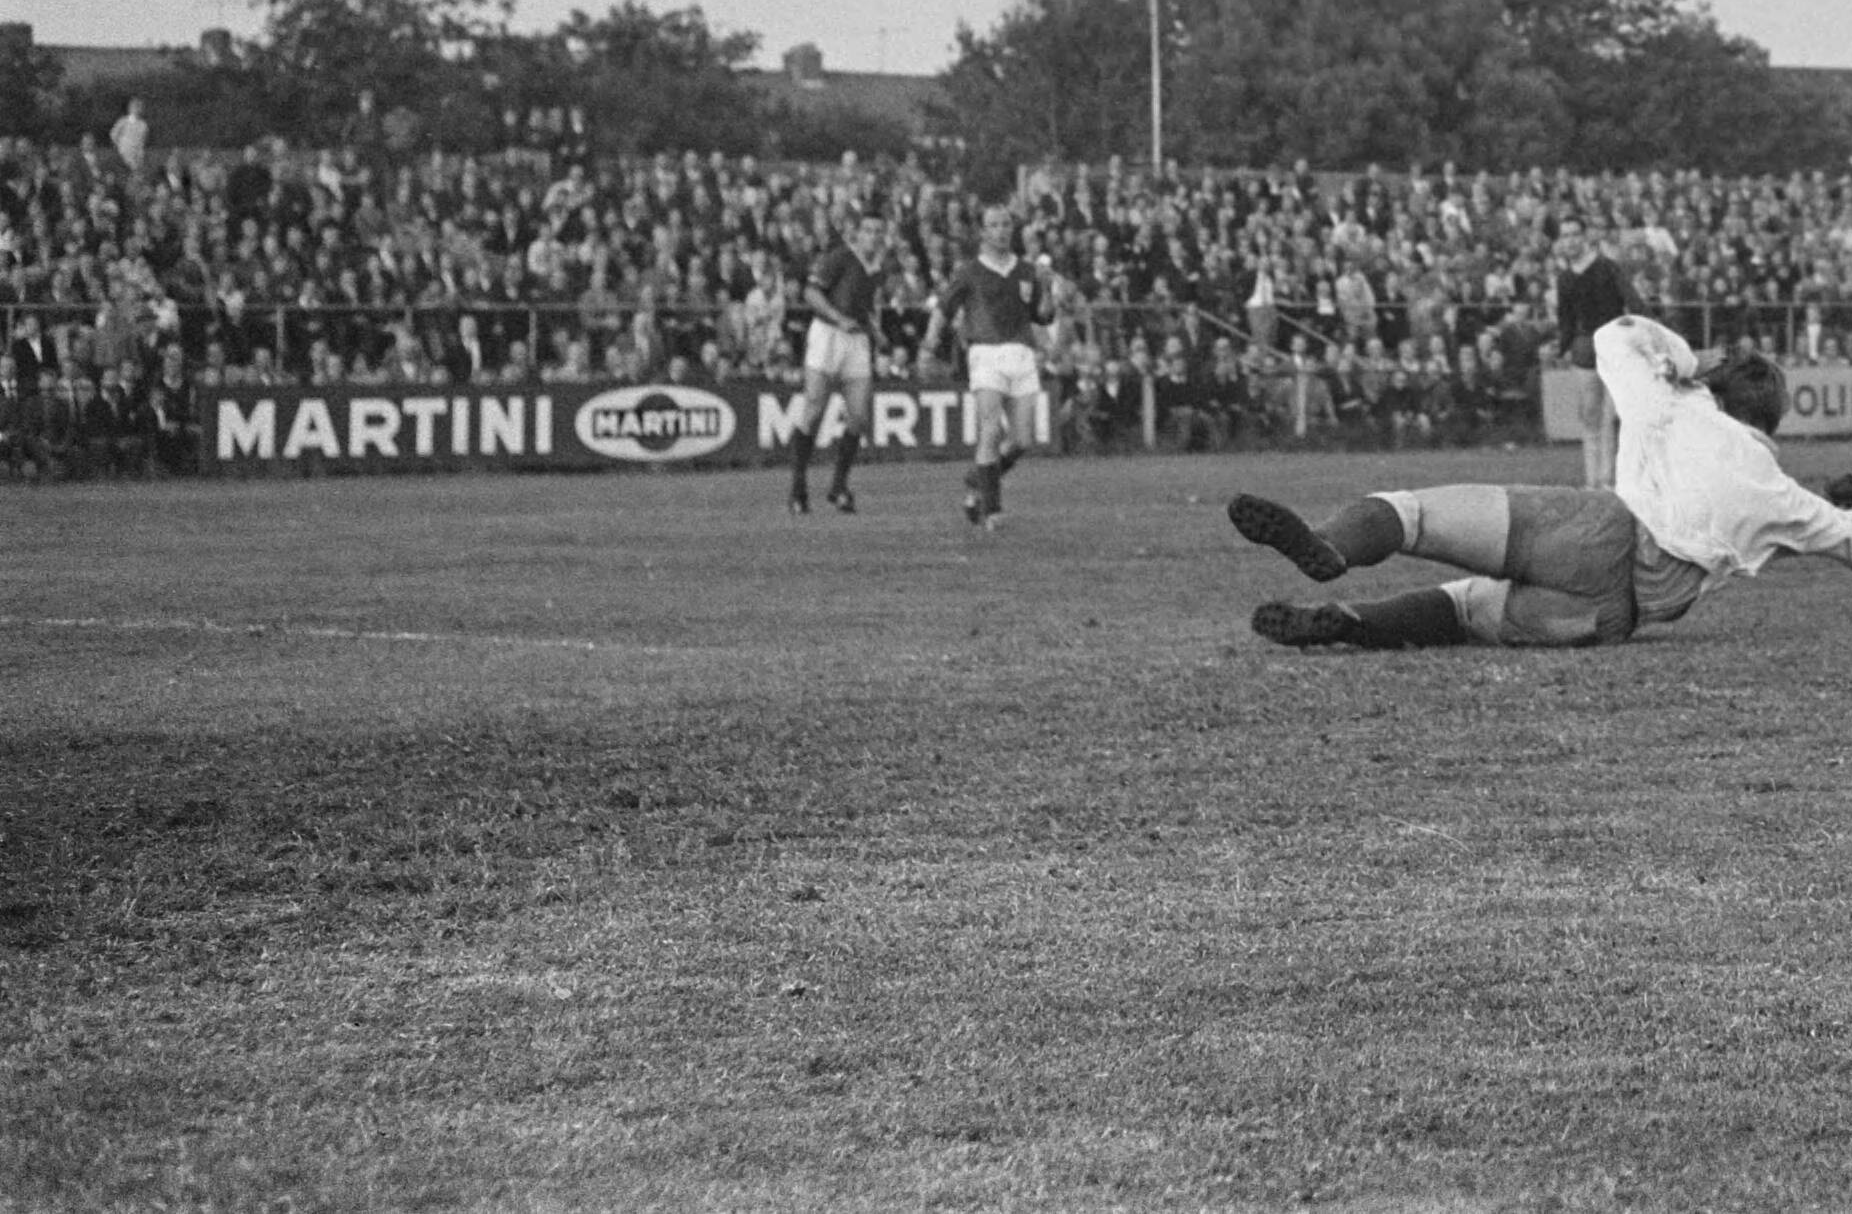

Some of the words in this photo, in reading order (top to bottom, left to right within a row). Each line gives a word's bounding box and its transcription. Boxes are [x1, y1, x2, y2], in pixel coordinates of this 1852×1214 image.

[216, 395, 553, 460] MARTINI
[594, 409, 718, 436] MARTINI
[757, 391, 1050, 449] MARTII
